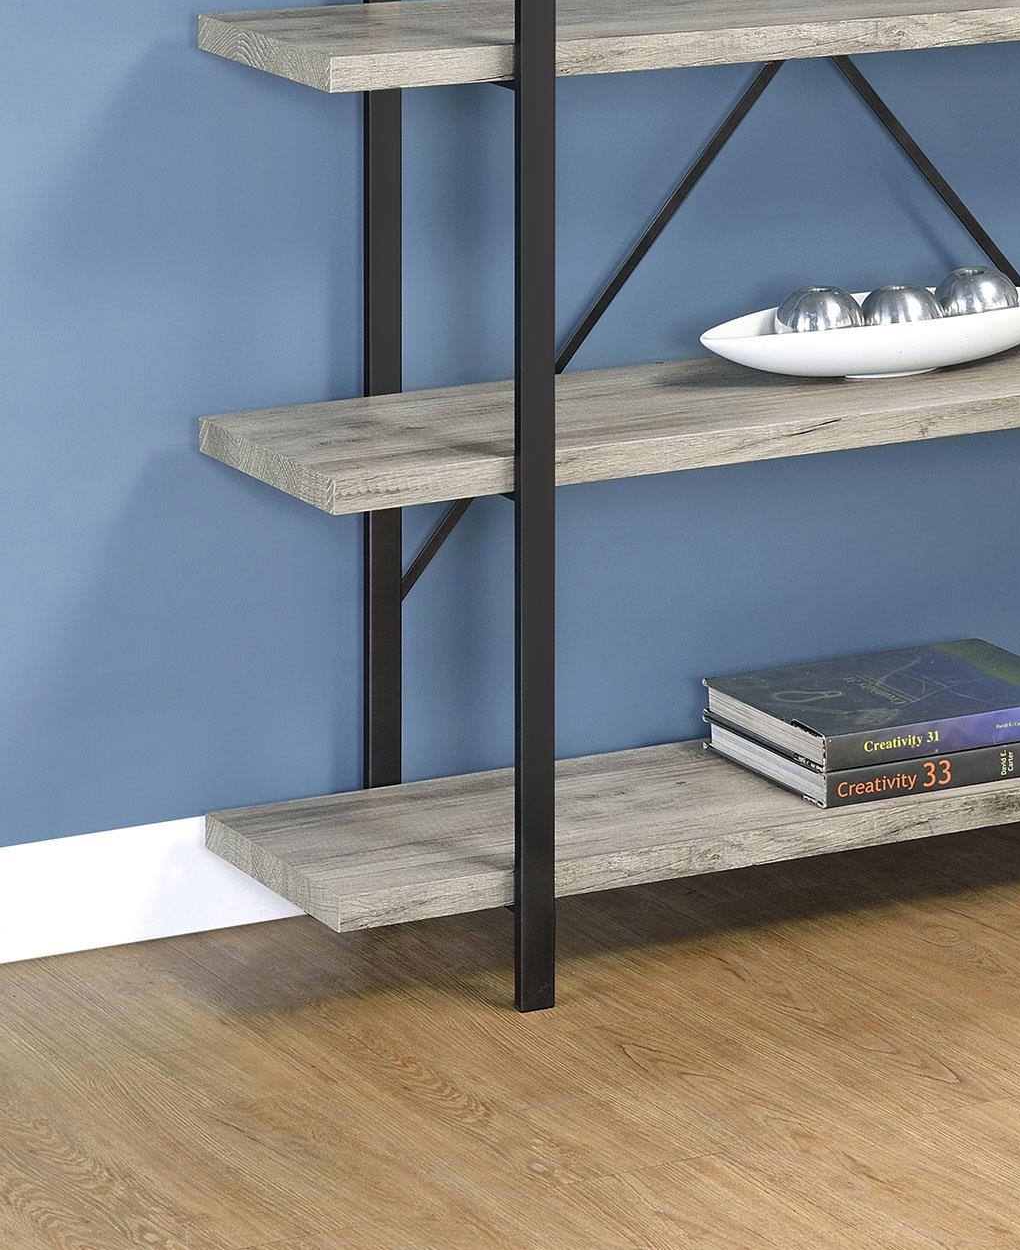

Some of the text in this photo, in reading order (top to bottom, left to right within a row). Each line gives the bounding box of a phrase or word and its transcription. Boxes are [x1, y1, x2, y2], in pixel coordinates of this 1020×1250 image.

[863, 730, 940, 753] Creativity 31
[837, 759, 952, 798] Creativity 33
